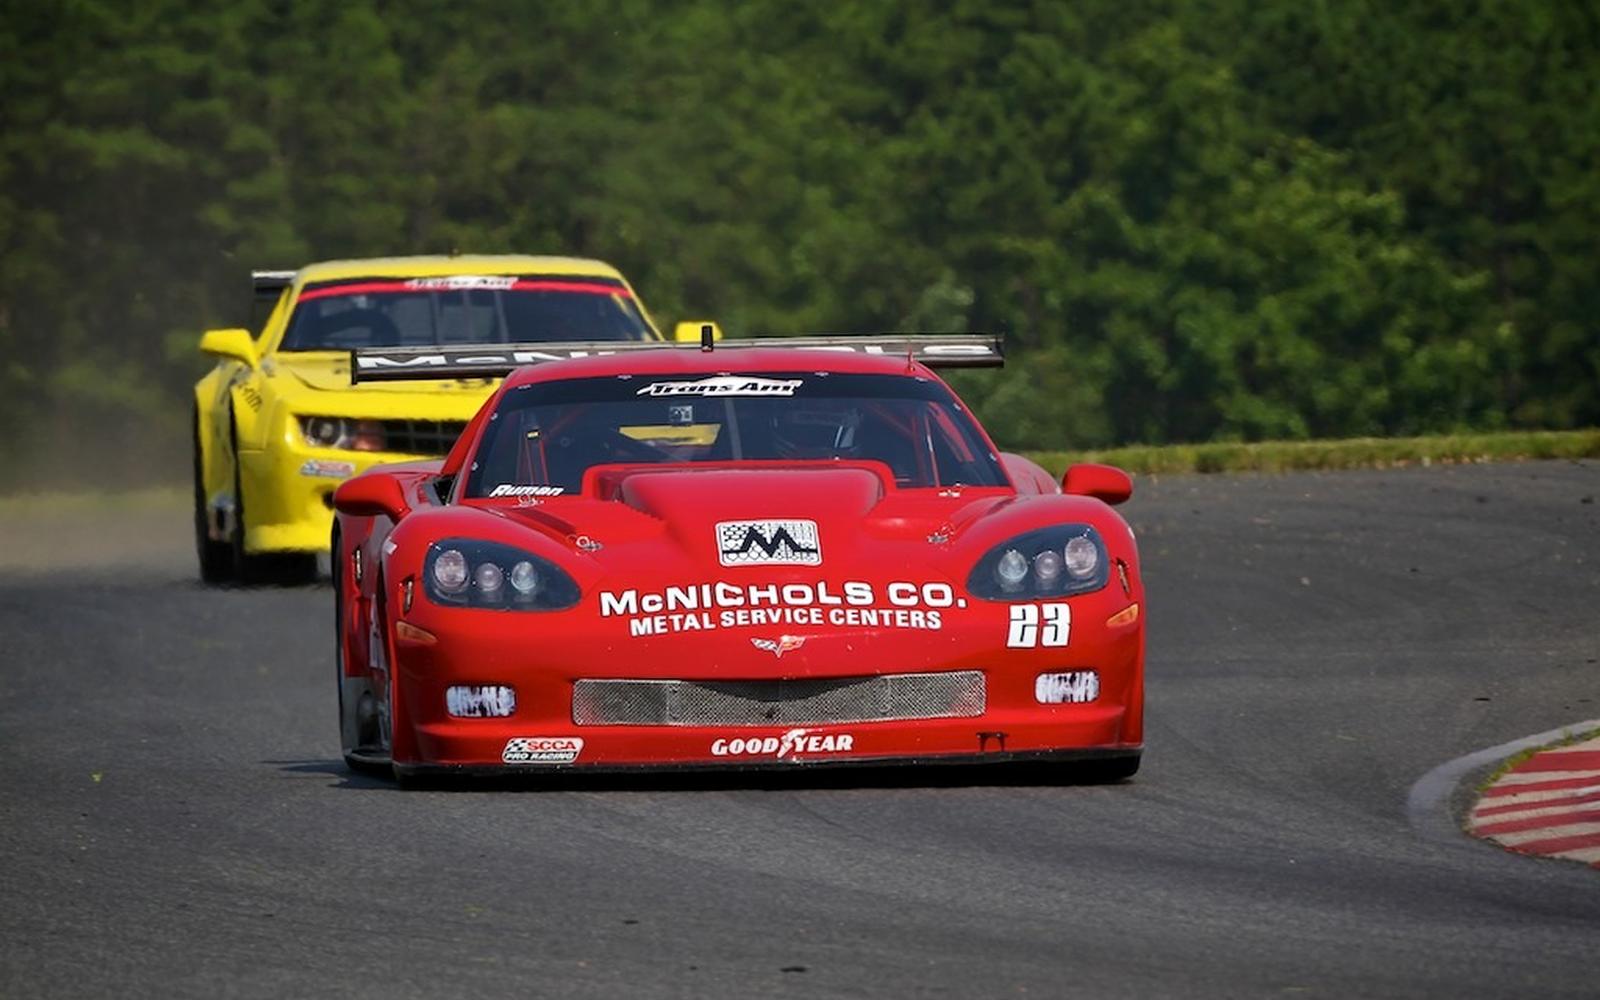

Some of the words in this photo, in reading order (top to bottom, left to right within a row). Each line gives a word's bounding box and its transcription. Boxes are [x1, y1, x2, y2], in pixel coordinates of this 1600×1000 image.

[650, 382, 733, 395] Trans
[737, 382, 795, 394] Am
[600, 581, 874, 616] McNICHOLS
[887, 582, 968, 608] CO.
[630, 612, 716, 636] METAL
[720, 608, 824, 627] SERVICE
[829, 608, 942, 630] CENTERS
[1006, 602, 1072, 648] 23
[527, 740, 577, 751] SCCA
[505, 752, 529, 761] PRO
[530, 752, 575, 761] RACING
